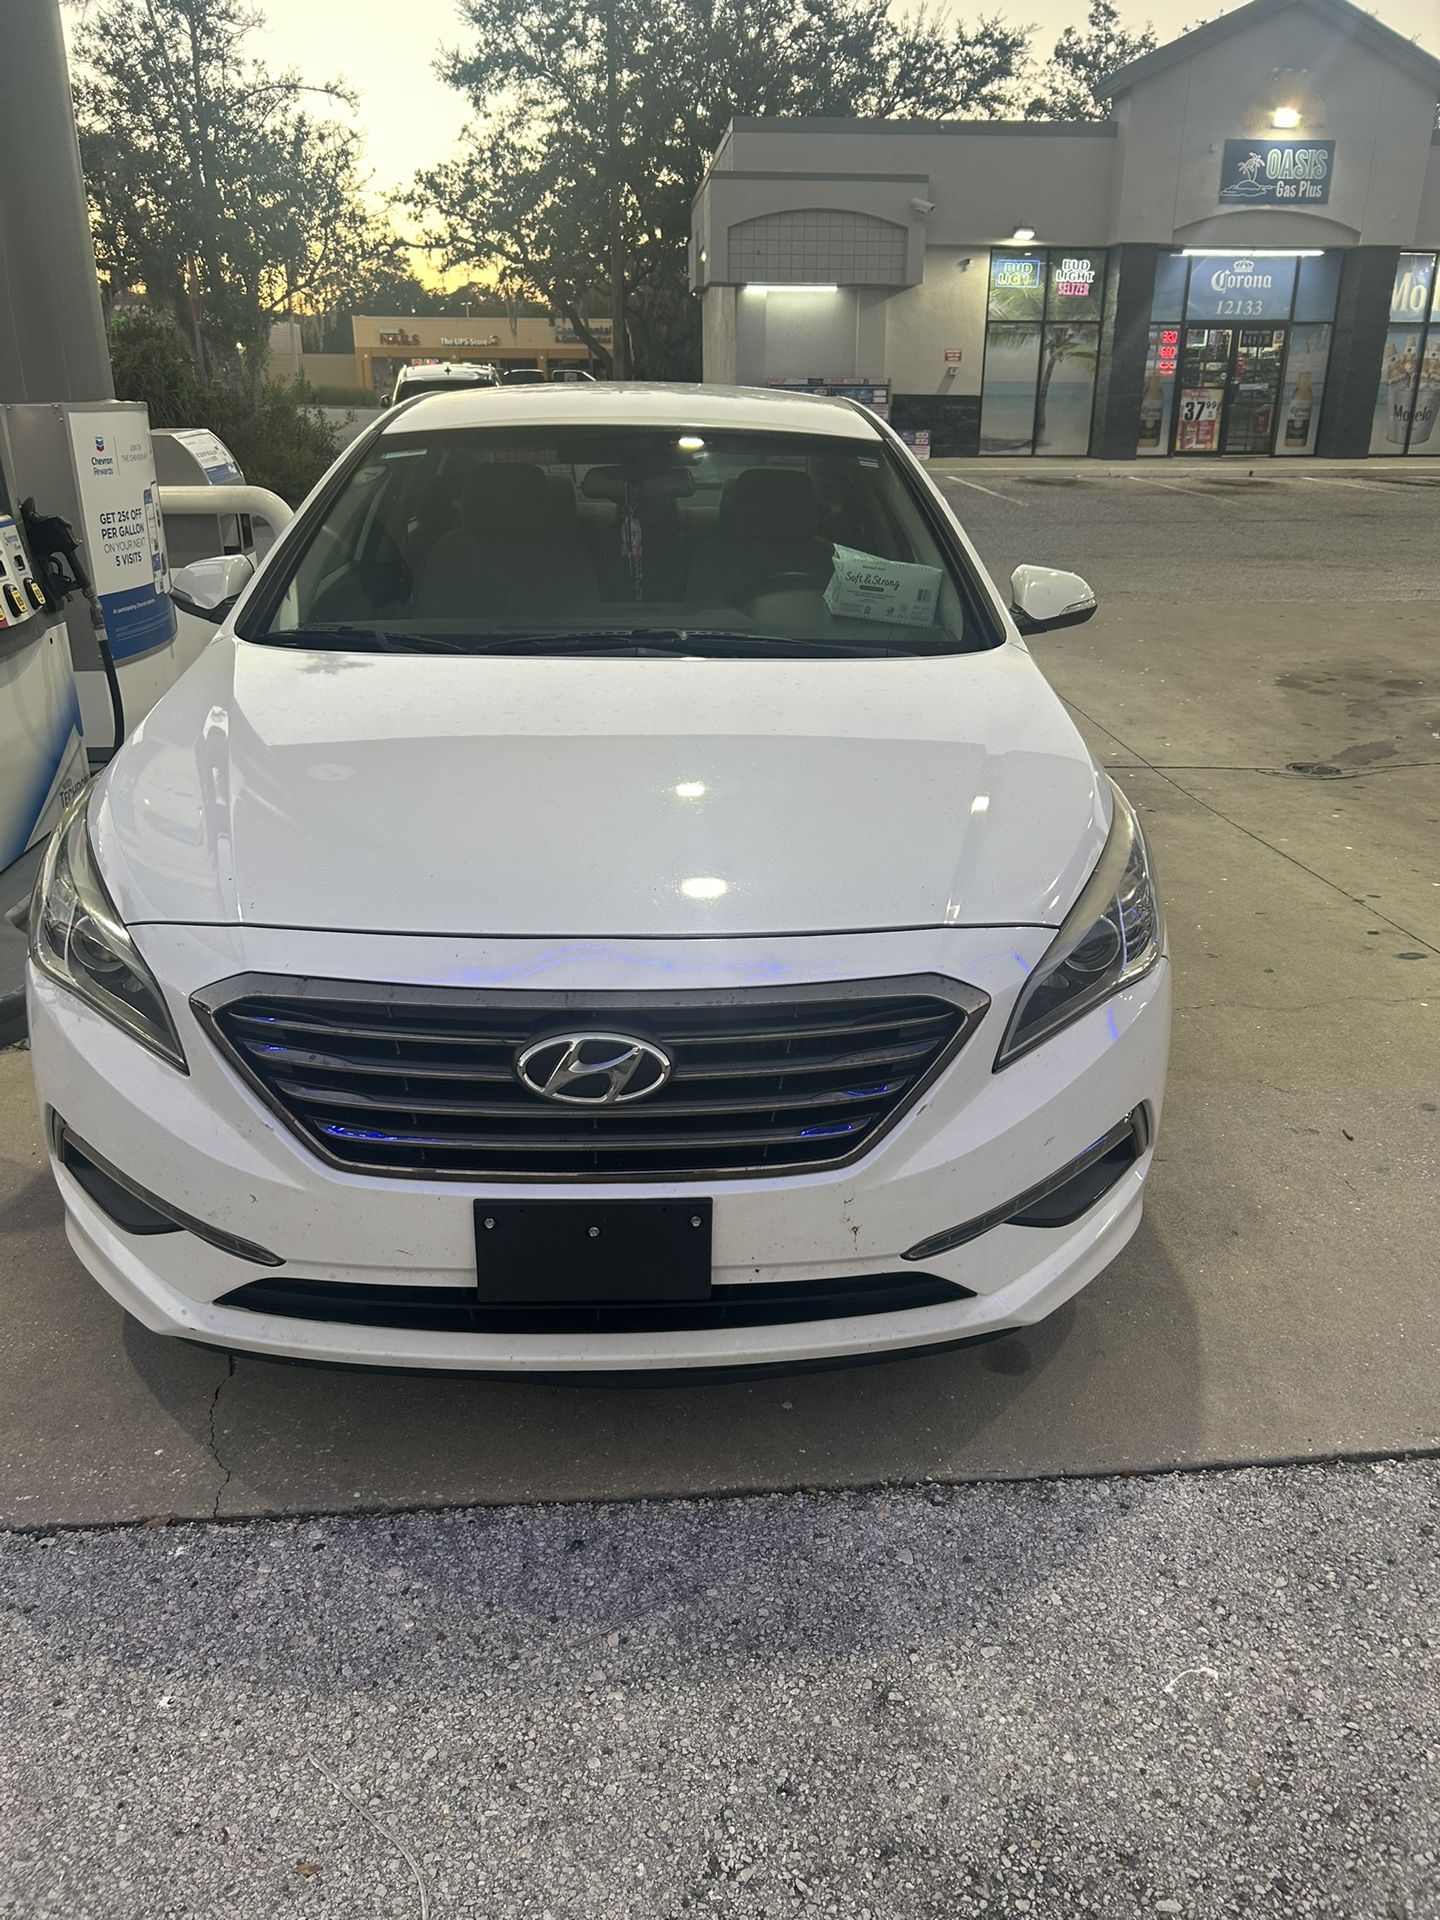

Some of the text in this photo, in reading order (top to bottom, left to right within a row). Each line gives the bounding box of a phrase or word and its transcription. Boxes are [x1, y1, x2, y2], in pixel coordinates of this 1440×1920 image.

[1266, 148, 1328, 179] OASIS
[1276, 180, 1322, 197] Gas Plus
[1004, 262, 1033, 273] BUD
[1062, 259, 1091, 271] BUD
[998, 272, 1034, 285] LIGH
[1055, 270, 1095, 283] LIGHT
[1211, 269, 1272, 294] Corona
[1058, 283, 1090, 296] SELTZER
[1391, 271, 1440, 312] Mo
[1215, 300, 1263, 315] 12133
[440, 336, 488, 347] The UPS Store
[1393, 404, 1432, 421] Moelo
[91, 457, 113, 466] Chevron
[93, 467, 113, 476] Rewards
[99, 508, 142, 525] GET 25¢ OFF
[101, 523, 145, 540] PER GALLON
[104, 543, 115, 554] ON
[116, 539, 133, 552] YOUR
[115, 552, 143, 567] 5 VISITS
[845, 571, 863, 584] Soft
[863, 574, 871, 584] &
[872, 575, 900, 591] Strong
